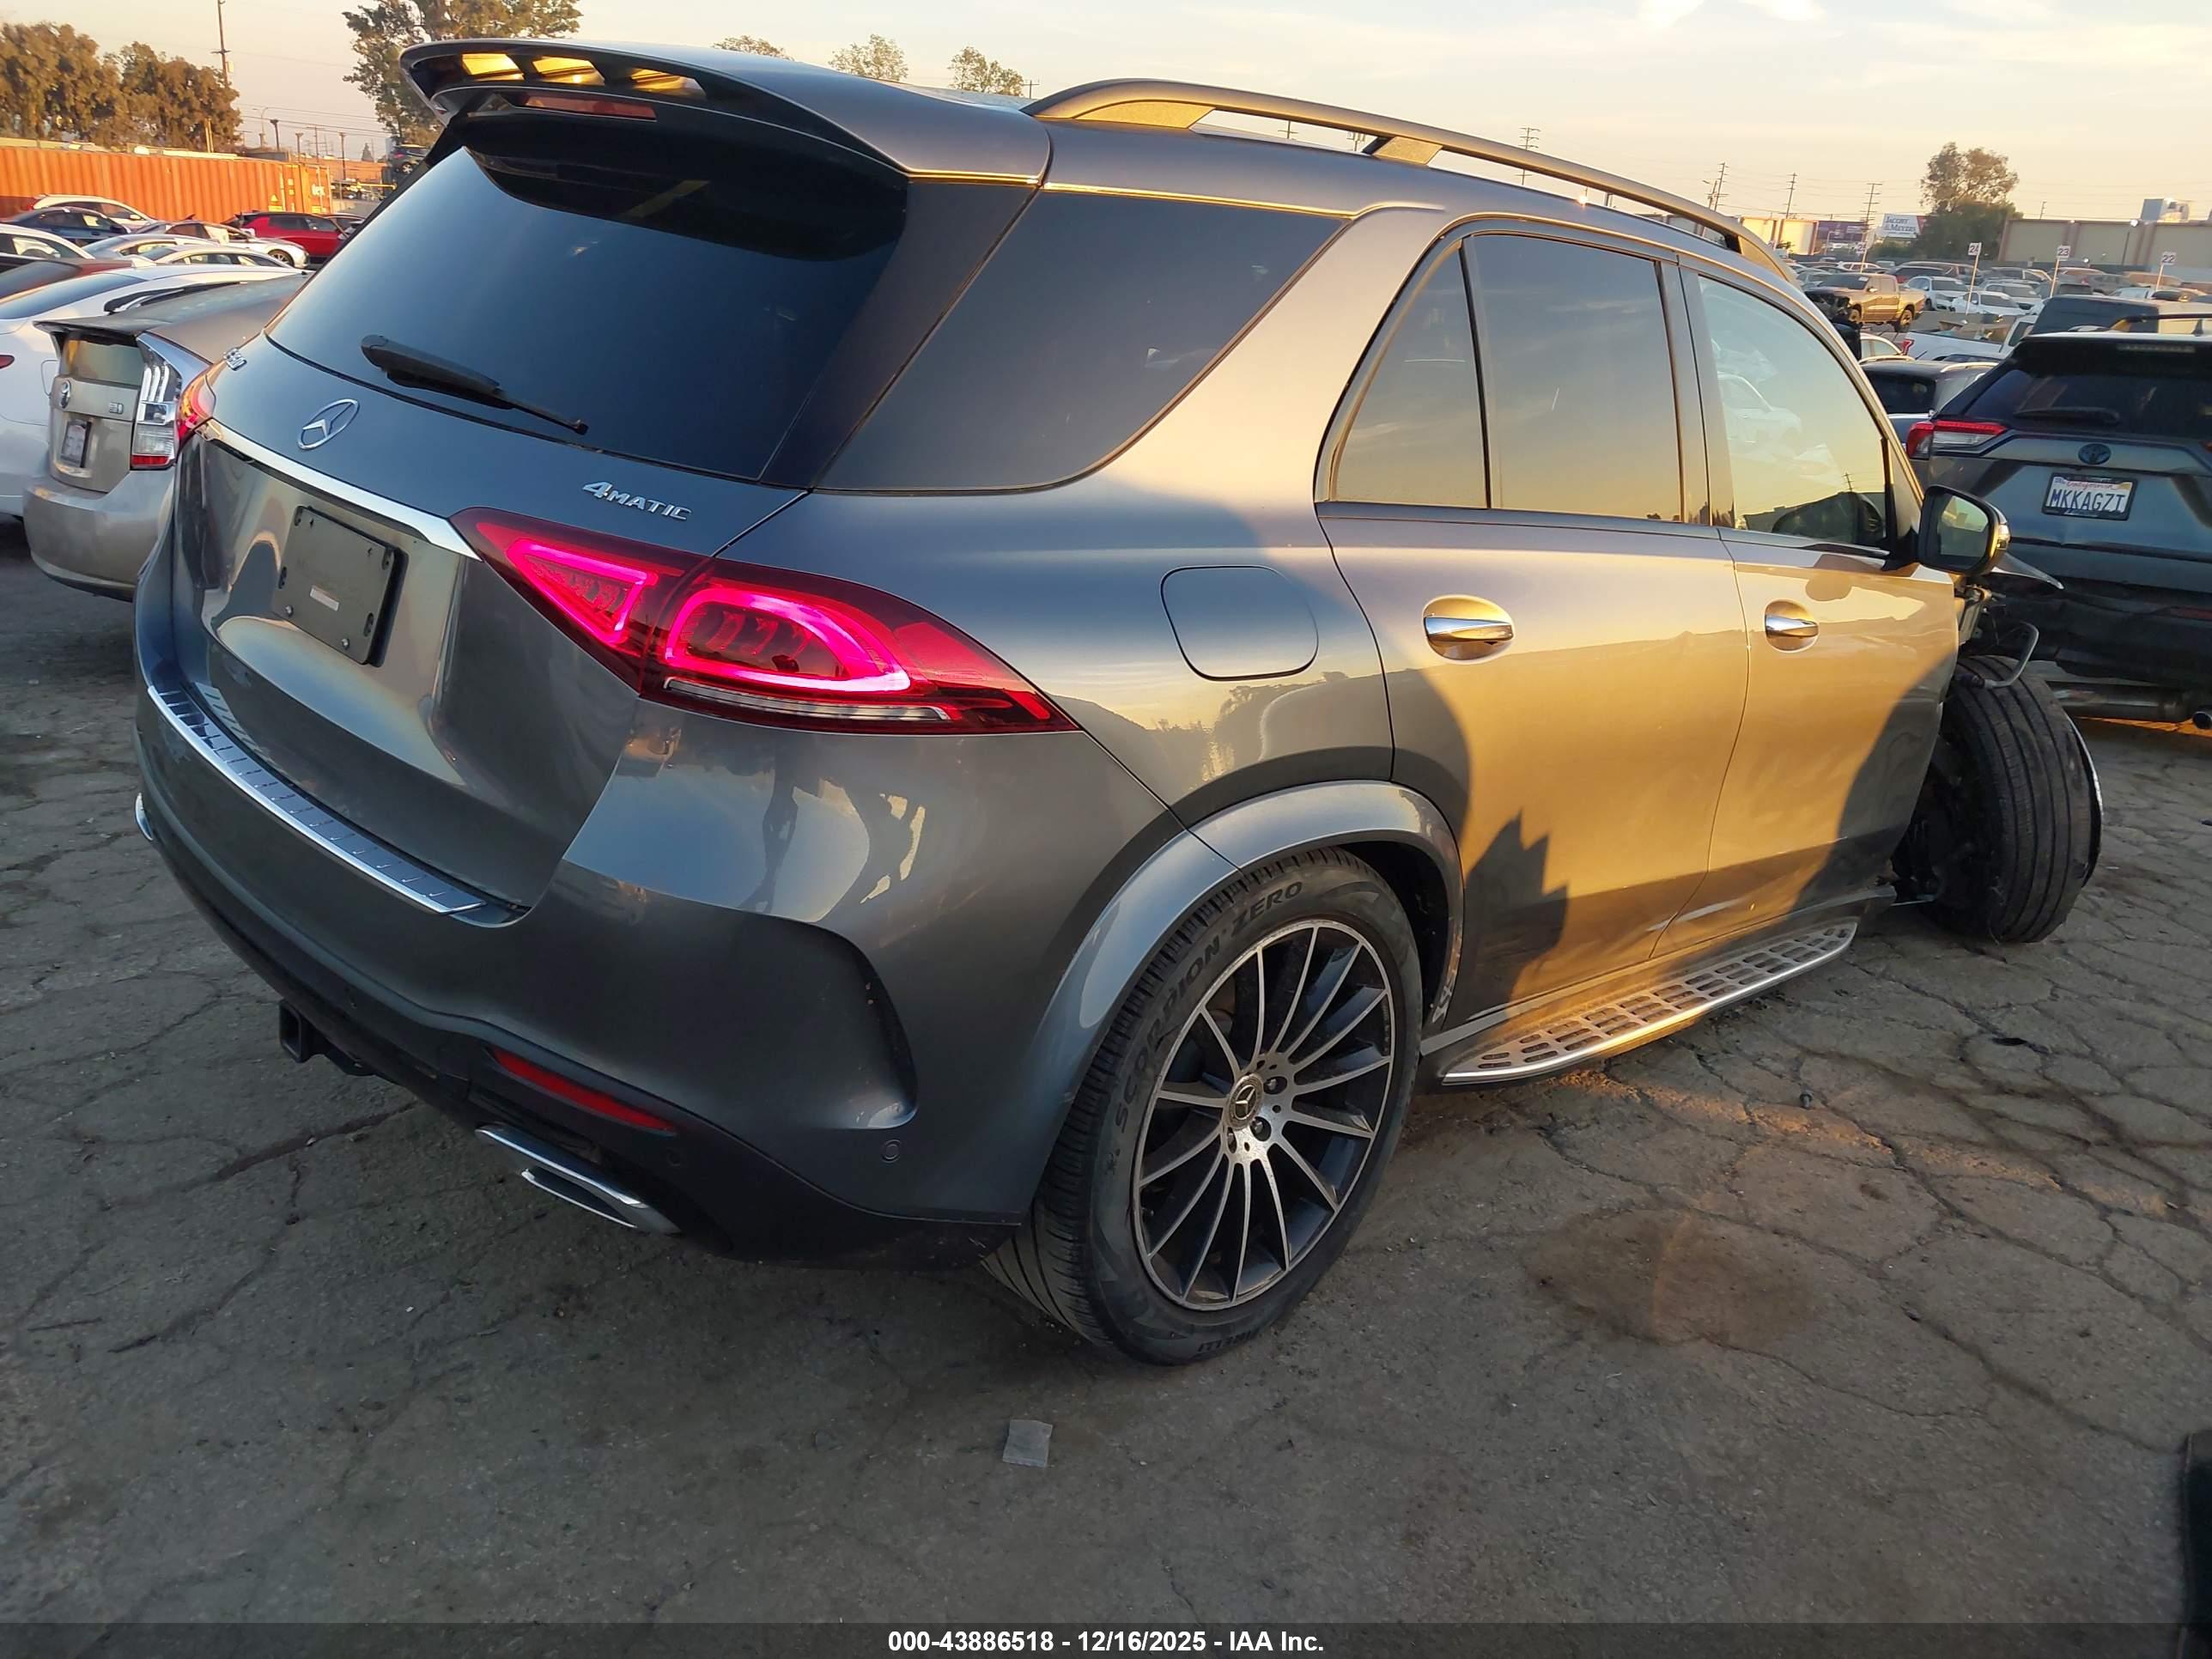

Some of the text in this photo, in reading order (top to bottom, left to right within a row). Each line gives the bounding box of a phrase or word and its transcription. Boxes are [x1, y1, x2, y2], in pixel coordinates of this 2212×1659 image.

[2161, 254, 2175, 264] 22
[582, 481, 692, 520] 4MATIC
[1115, 880, 1304, 1135] SCORPION ZERO
